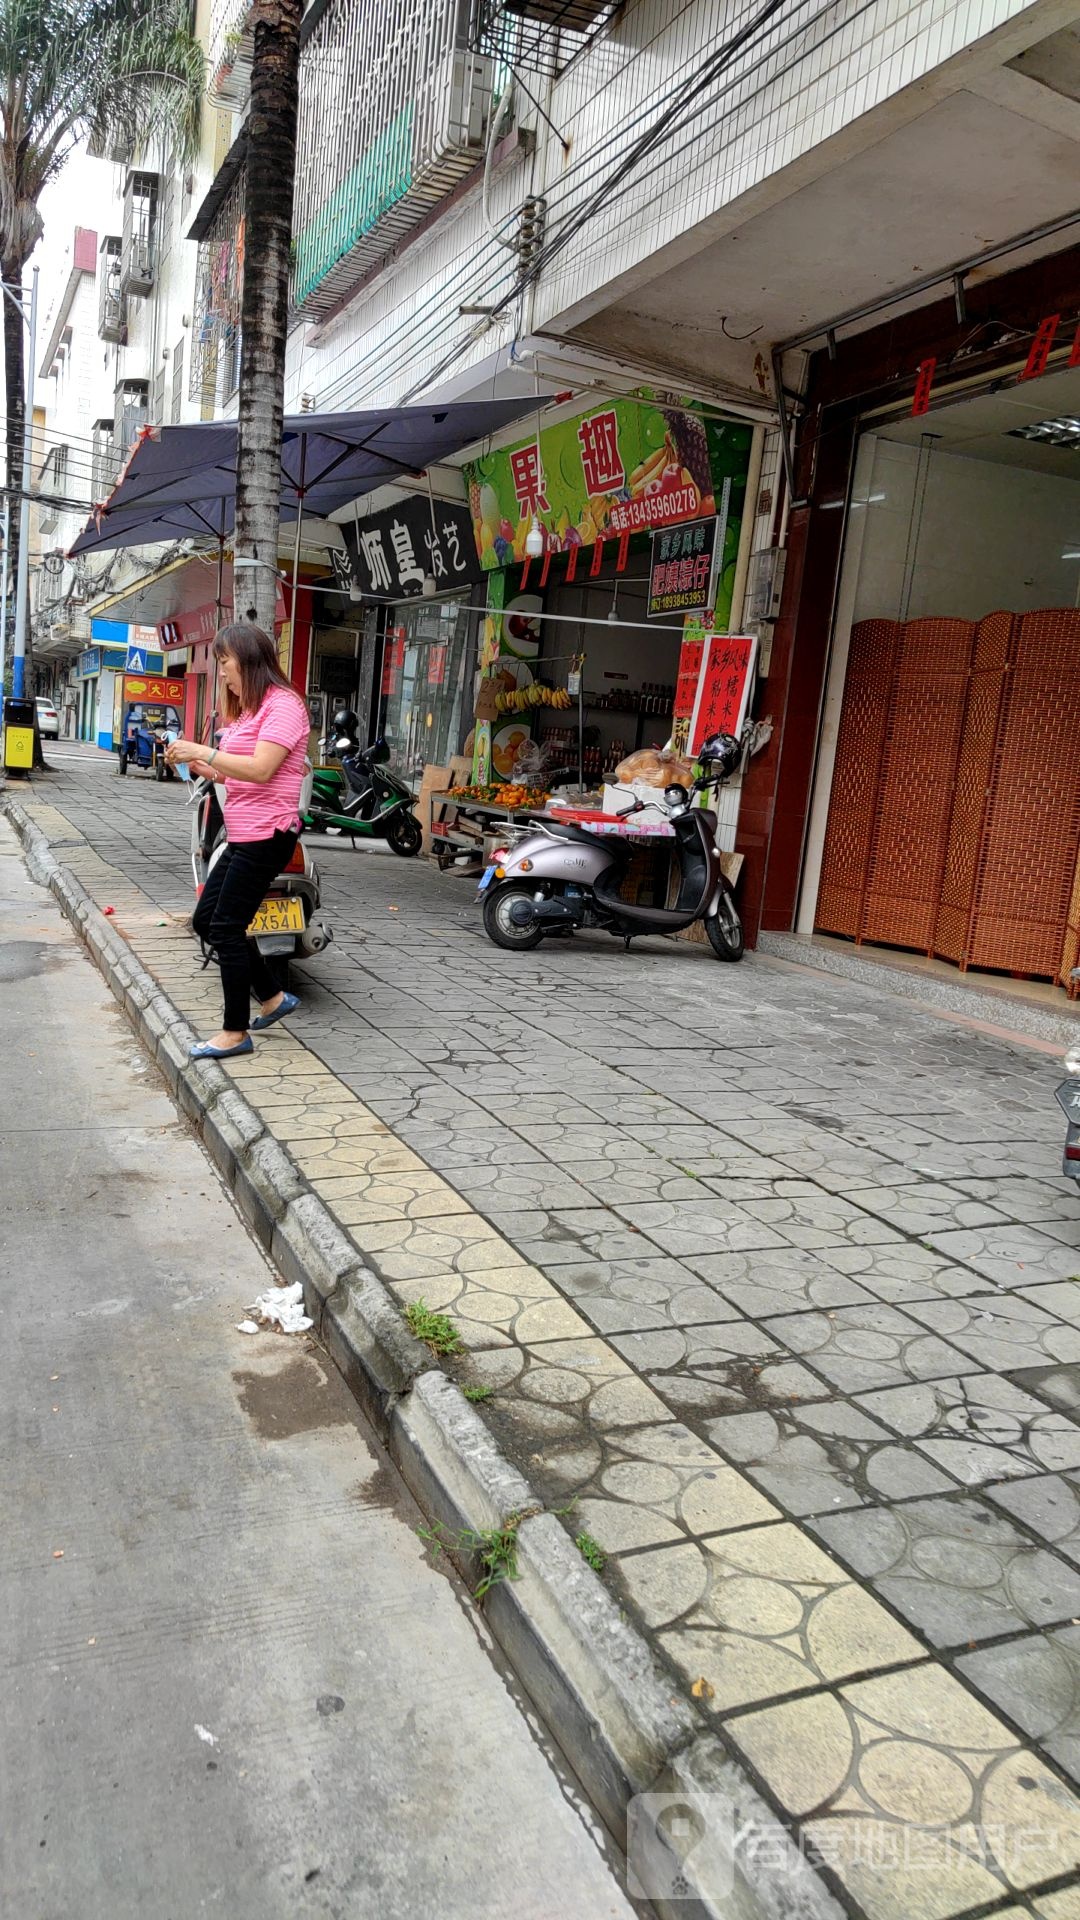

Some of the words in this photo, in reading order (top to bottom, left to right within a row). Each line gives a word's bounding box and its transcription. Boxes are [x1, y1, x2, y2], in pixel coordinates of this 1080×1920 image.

[610, 486, 697, 530] 电话:13435960278
[709, 645, 749, 673] 家乡风味
[151, 684, 181, 698] 大包
[251, 914, 298, 932] 2X541
